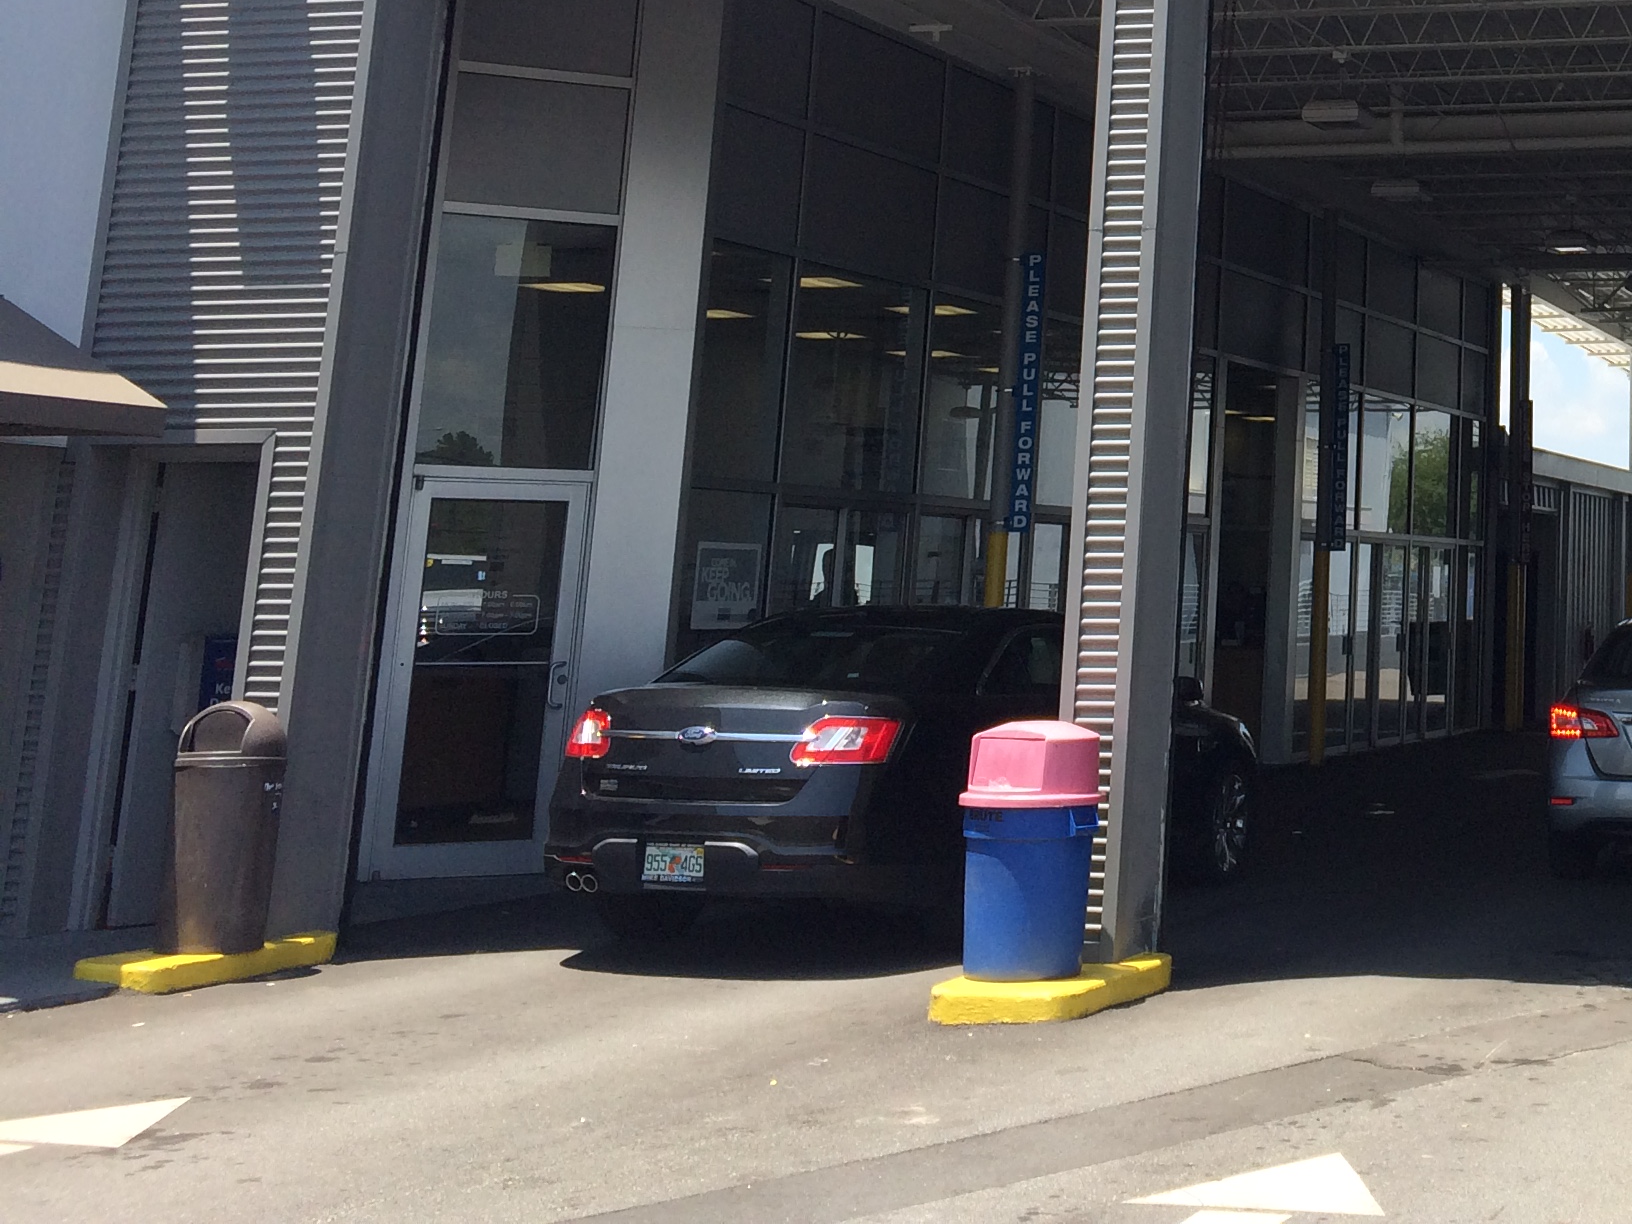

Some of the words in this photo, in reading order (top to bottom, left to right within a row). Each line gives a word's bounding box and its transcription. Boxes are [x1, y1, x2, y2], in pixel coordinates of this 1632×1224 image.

[1025, 254, 1042, 343] PLEASE
[1021, 353, 1037, 411] PULL
[1337, 345, 1348, 410] PLEASE
[1337, 418, 1346, 462] PULL
[1013, 422, 1033, 528] FORWARD
[1522, 472, 1531, 511] STOP
[1333, 469, 1345, 549] FORWARD
[702, 567, 730, 582] KEEP
[215, 682, 231, 694] Ke
[646, 853, 668, 872] 955
